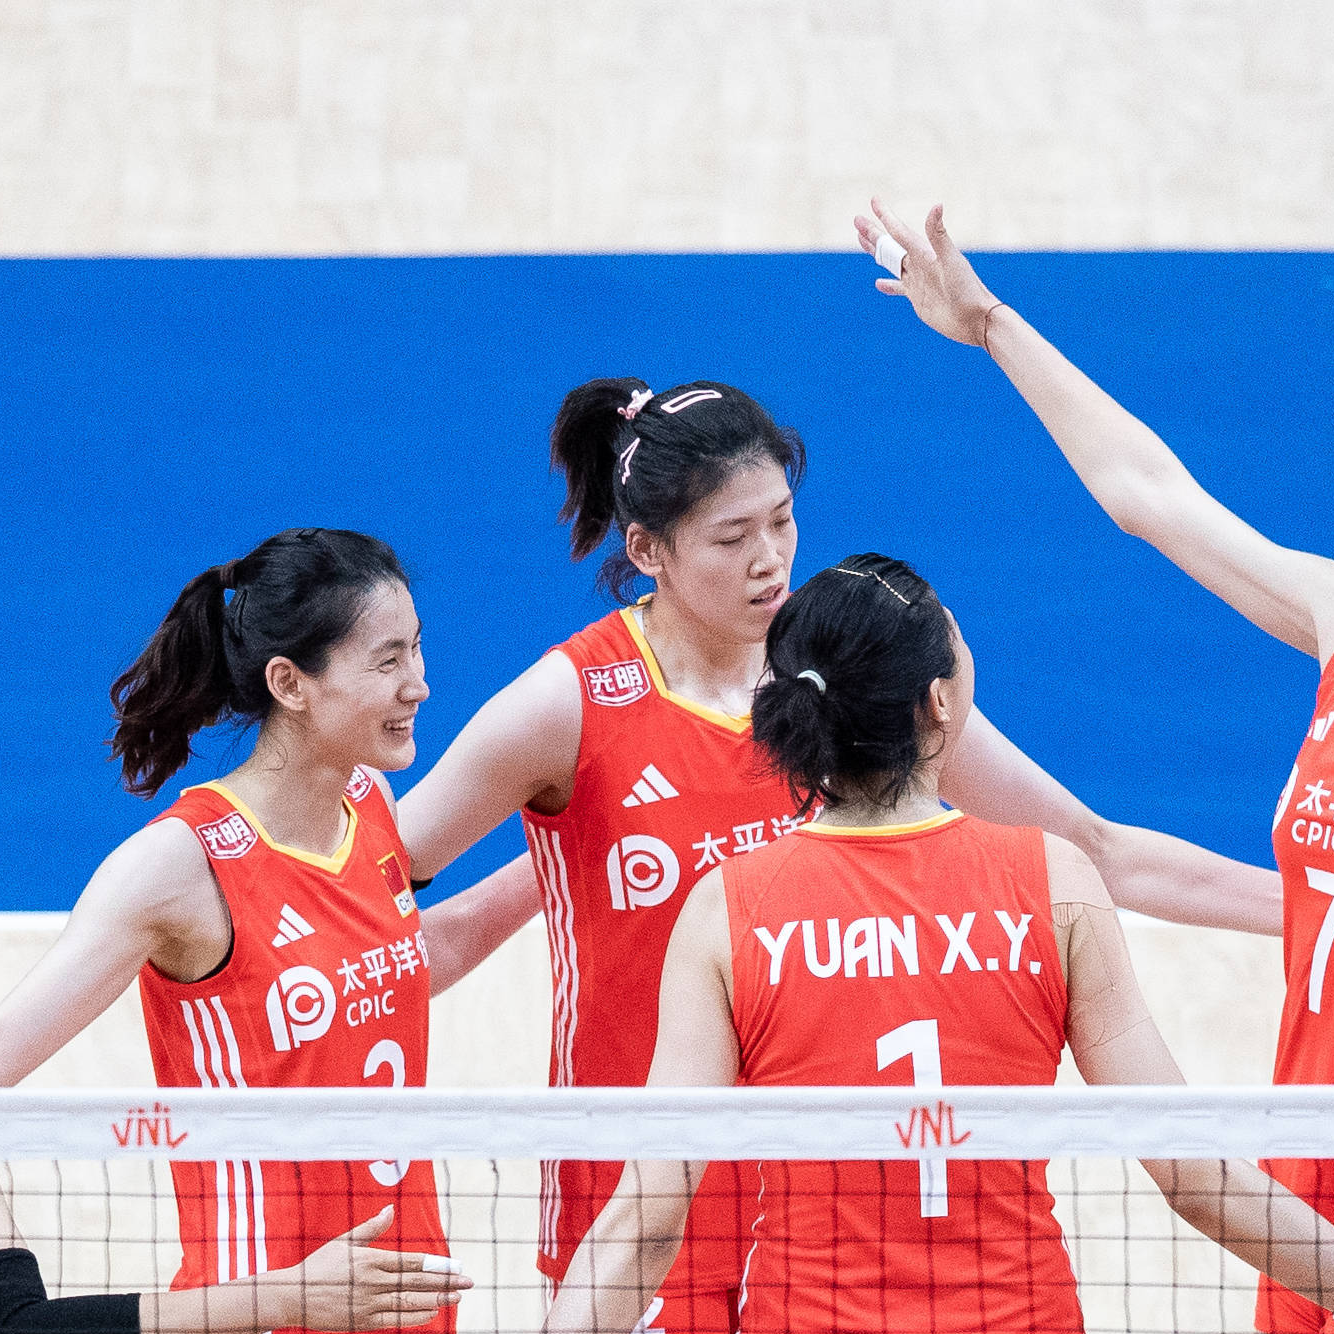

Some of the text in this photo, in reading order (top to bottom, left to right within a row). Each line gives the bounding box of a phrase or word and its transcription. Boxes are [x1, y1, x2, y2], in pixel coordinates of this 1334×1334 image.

[588, 664, 644, 693] 光明
[201, 814, 252, 850] 光明
[753, 910, 1042, 986] YUAN X.Y.
[346, 989, 396, 1027] CPIC
[112, 1102, 188, 1148] VNL
[876, 1019, 948, 1218] 1
[895, 1100, 971, 1148] VNL
